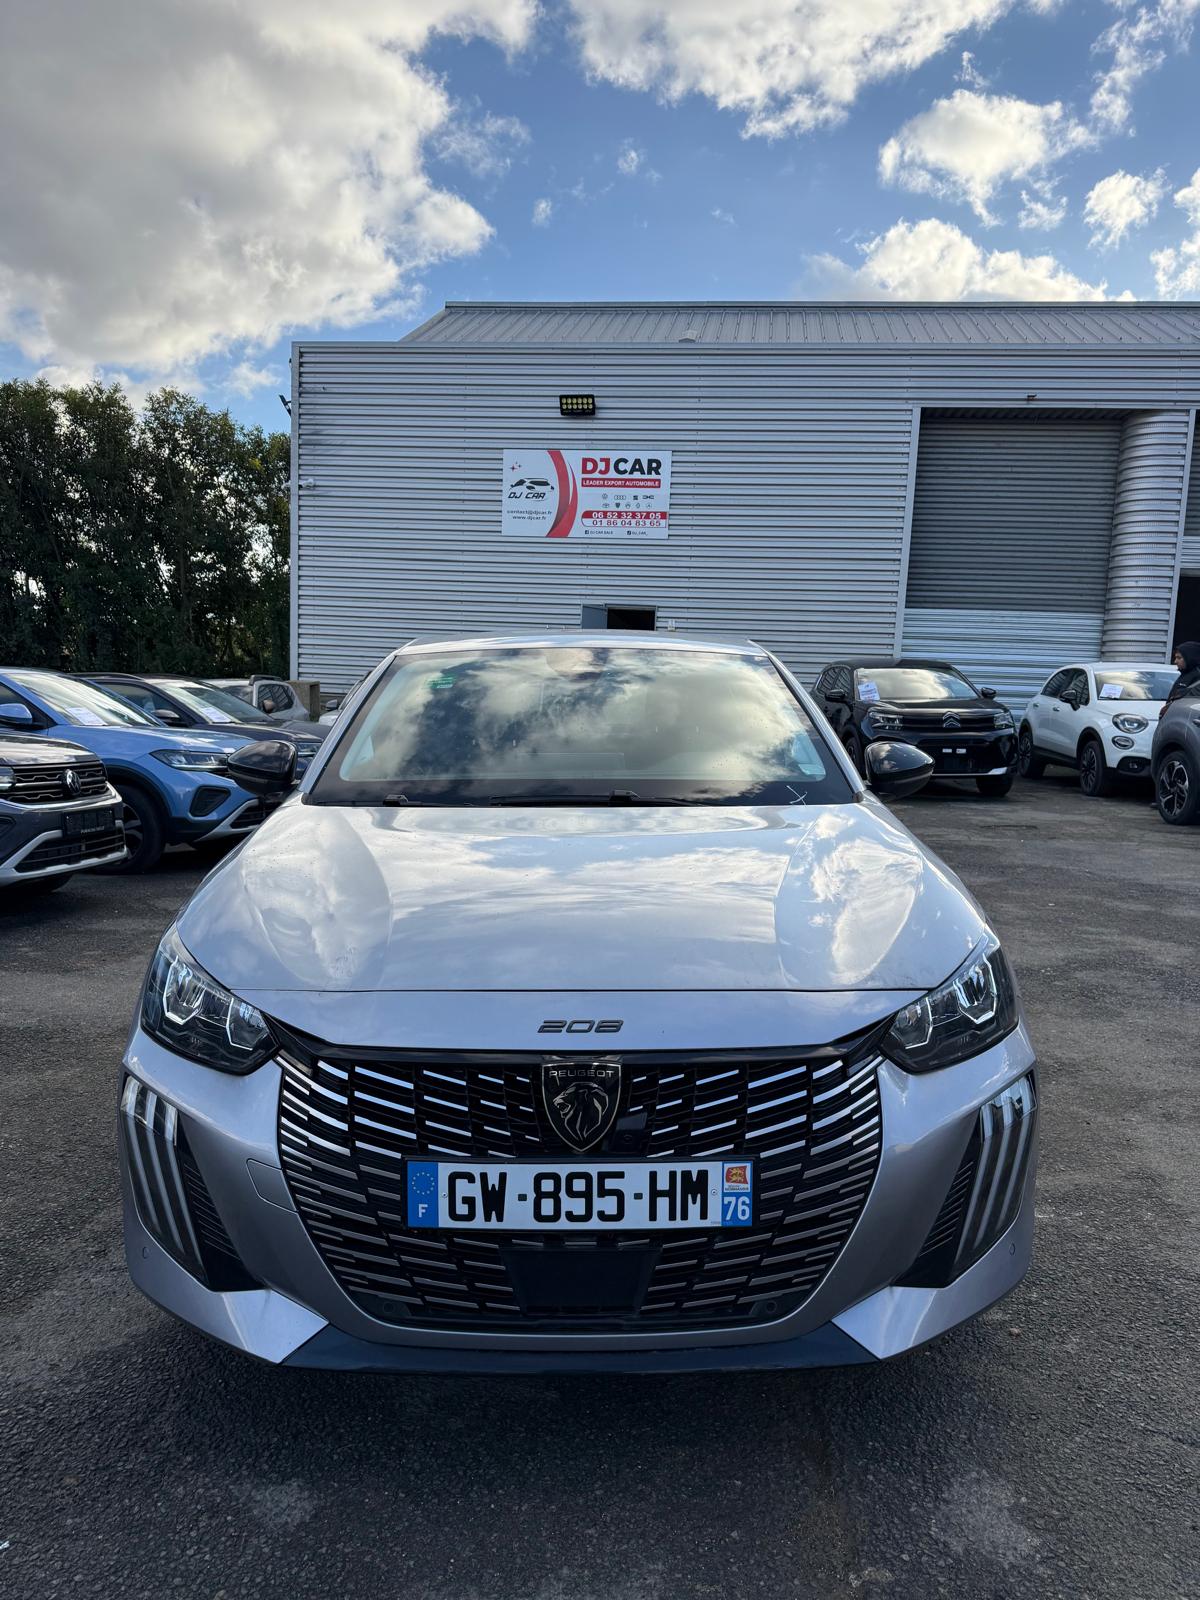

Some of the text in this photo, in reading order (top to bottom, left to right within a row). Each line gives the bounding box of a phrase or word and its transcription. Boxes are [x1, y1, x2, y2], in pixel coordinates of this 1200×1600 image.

[581, 457, 662, 476] DJ CAR
[507, 491, 546, 500] DJ CAR
[592, 511, 604, 519] 06
[649, 512, 662, 520] 05
[537, 1019, 624, 1034] 208
[548, 1069, 615, 1079] PEUGEOT
[447, 1169, 709, 1223] GW-895-HM
[418, 1204, 428, 1218] F
[723, 1196, 750, 1221] 76
